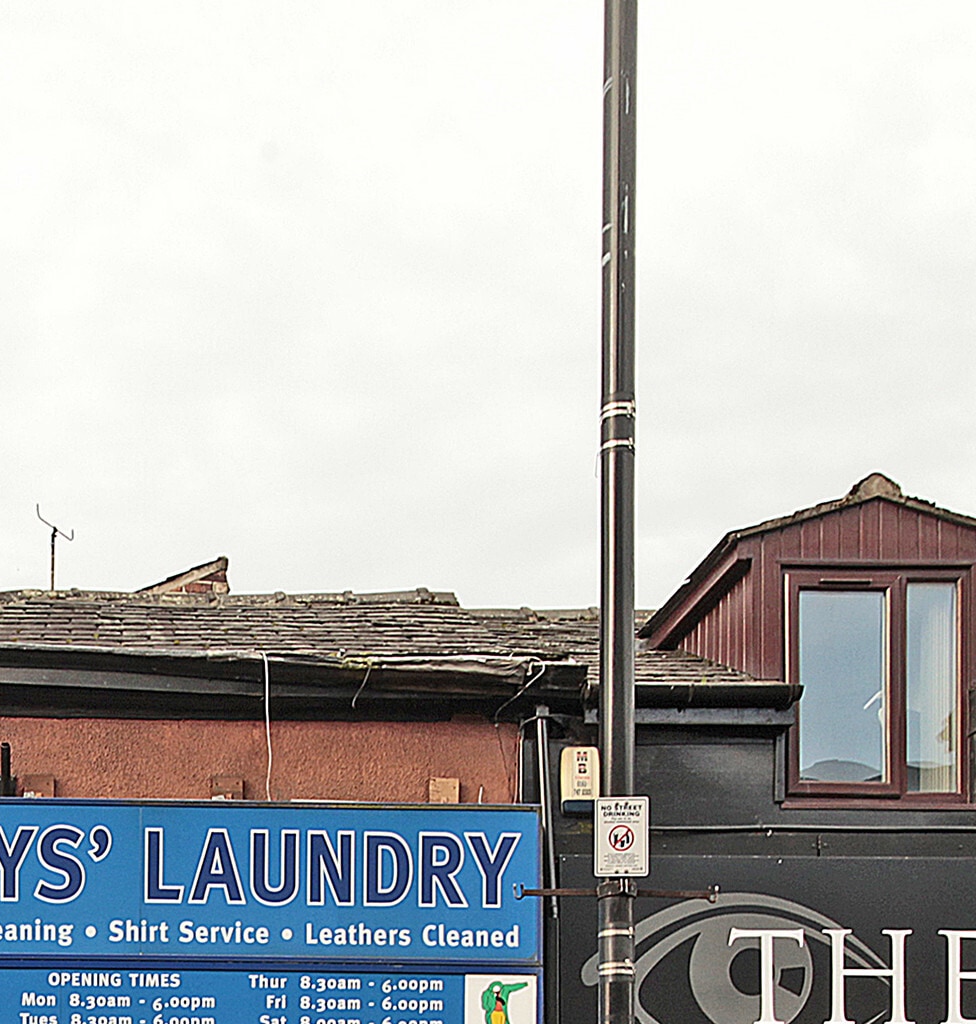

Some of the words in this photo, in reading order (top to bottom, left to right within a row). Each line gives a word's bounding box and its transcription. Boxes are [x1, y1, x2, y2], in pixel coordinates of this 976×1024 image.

[615, 803, 642, 811] STREET
[144, 826, 522, 909] LAUNDRY
[109, 920, 169, 943] Shirt
[179, 921, 270, 945] Service
[306, 923, 411, 946] Leathers
[422, 924, 520, 948] Cleaned
[48, 973, 122, 988] OPENING
[129, 974, 181, 988] TIMES
[249, 975, 287, 989] Thur
[300, 976, 361, 992] 8.30am
[381, 977, 444, 993] 6.00pm
[22, 993, 56, 1007] Mon
[69, 994, 131, 1010] 8.30am
[152, 995, 215, 1012] 6.00pm
[266, 995, 287, 1009] Fri
[300, 996, 361, 1011] 8.30am
[381, 997, 444, 1013] 6.00pm
